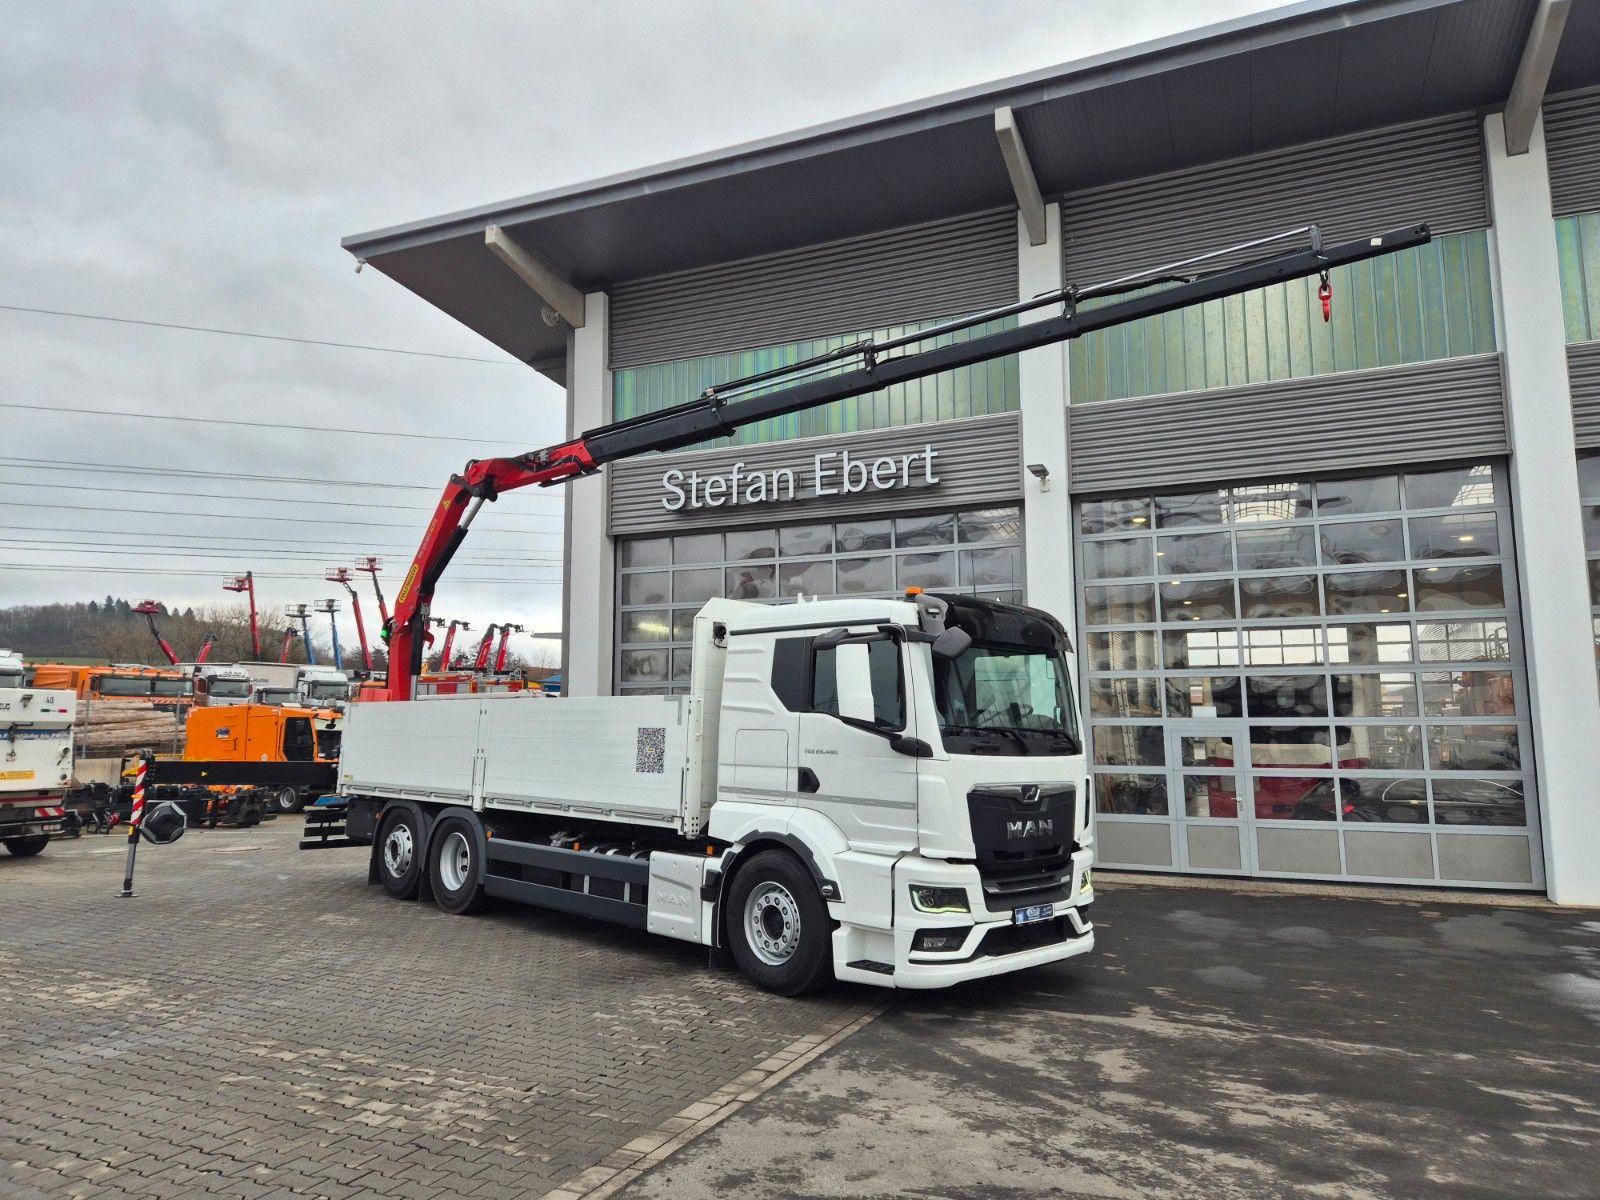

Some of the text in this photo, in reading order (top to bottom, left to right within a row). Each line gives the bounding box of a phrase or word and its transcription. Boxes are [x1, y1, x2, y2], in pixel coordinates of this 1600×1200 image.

[661, 443, 940, 511] Stefan Ebert
[1006, 819, 1054, 839] MAN
